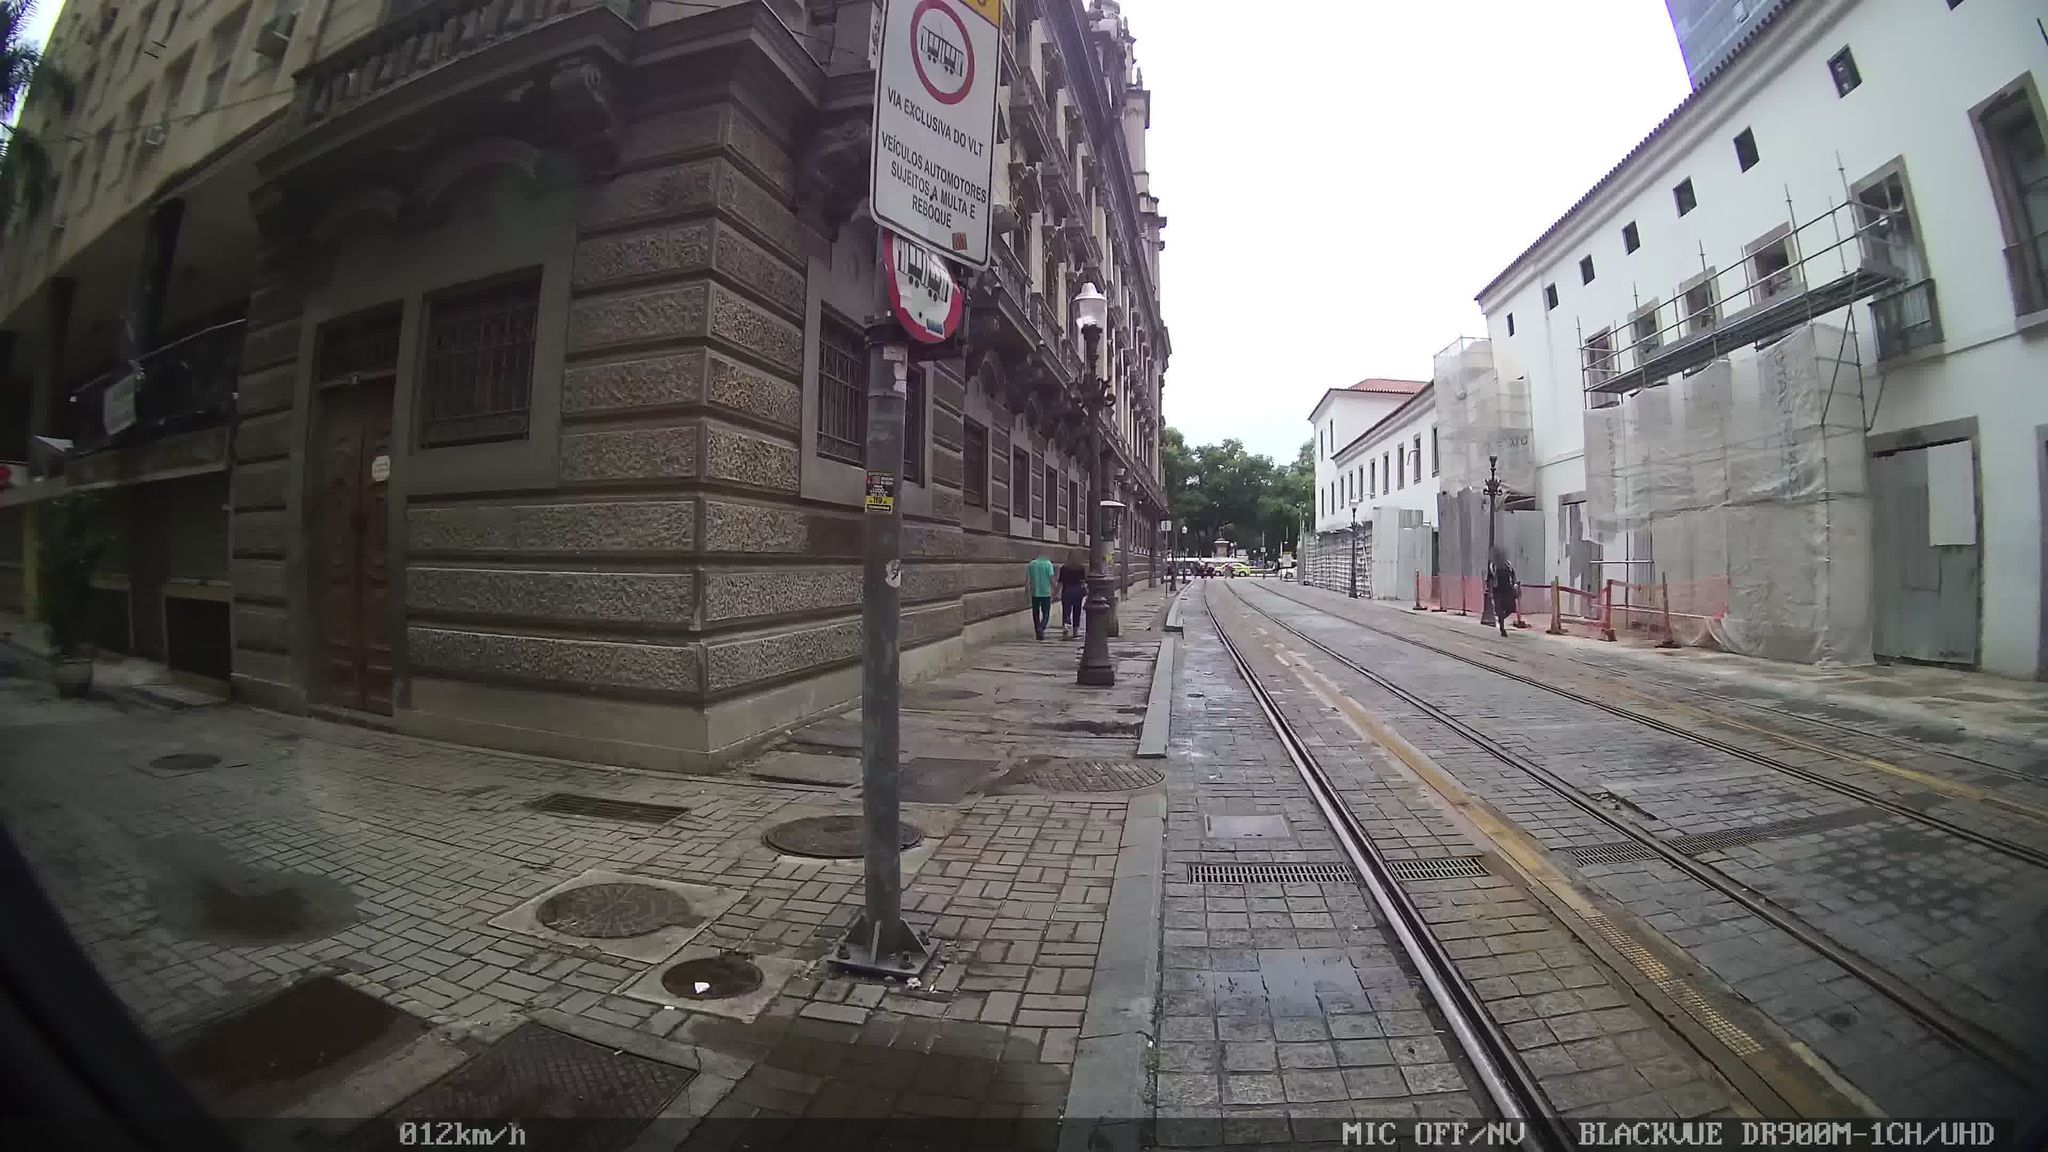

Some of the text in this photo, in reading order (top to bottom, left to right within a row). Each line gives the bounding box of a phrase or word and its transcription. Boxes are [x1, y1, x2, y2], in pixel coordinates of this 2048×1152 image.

[888, 86, 984, 157] VIA EXCLUSIVA DO VLT
[881, 131, 986, 203] VEÍCULOS AUTOMOTORES
[891, 160, 976, 219] SUJEITOS A MULTA E
[912, 194, 952, 228] REBOQUE
